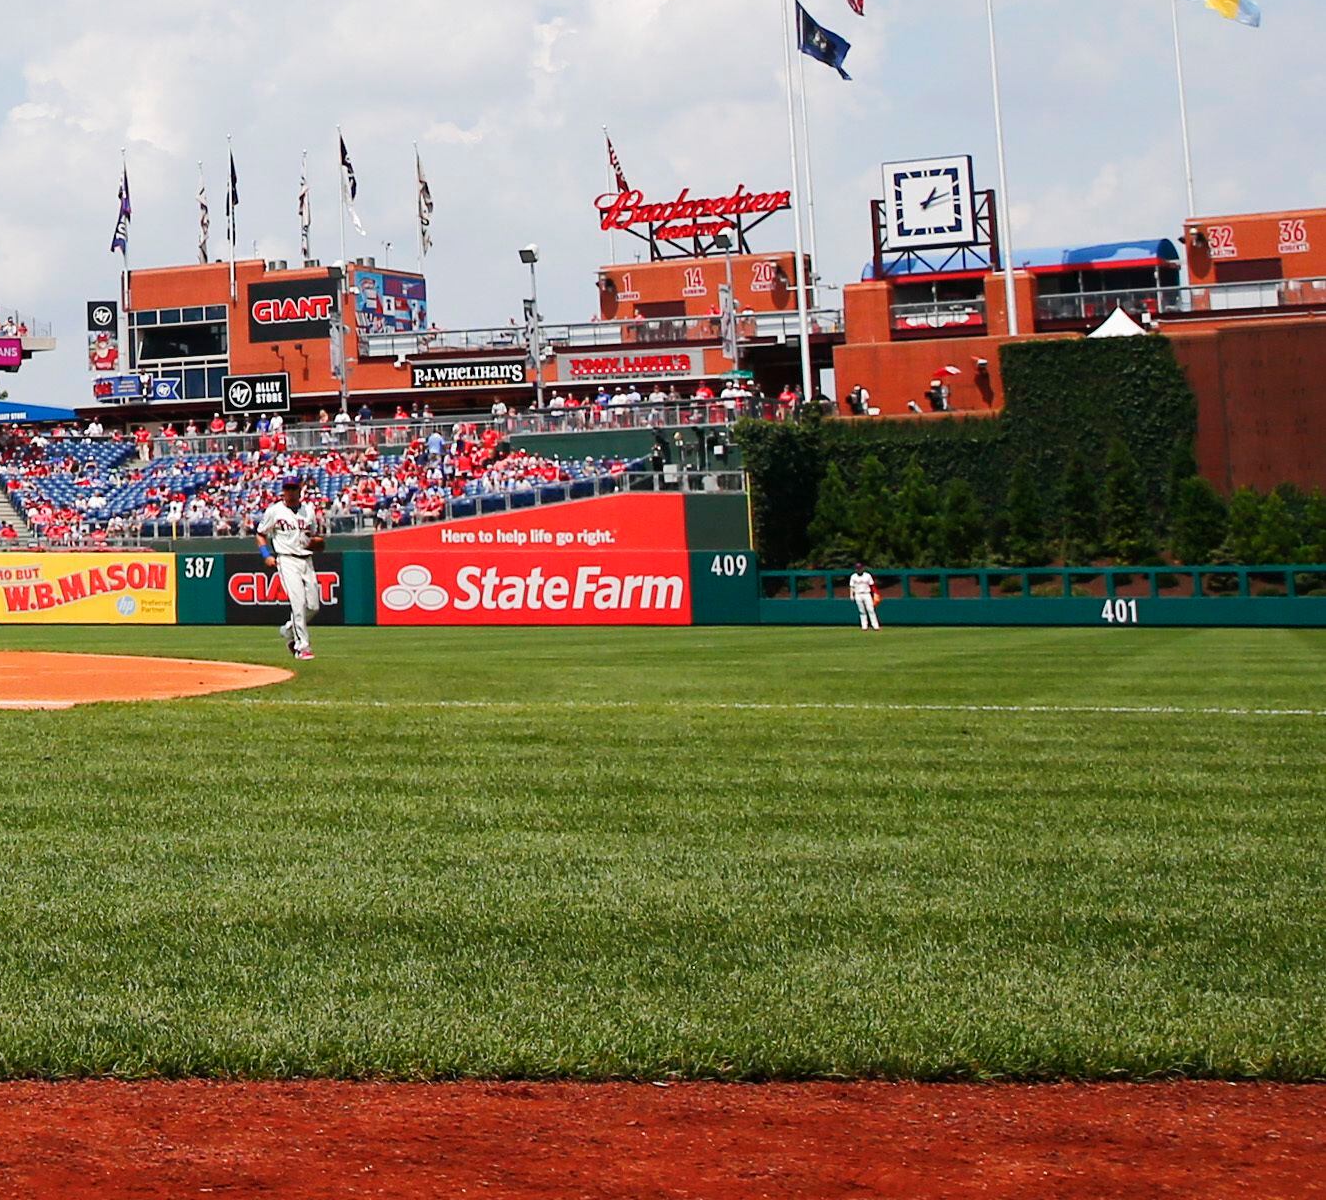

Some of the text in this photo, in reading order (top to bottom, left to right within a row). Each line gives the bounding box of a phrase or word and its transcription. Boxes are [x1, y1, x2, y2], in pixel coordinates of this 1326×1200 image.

[595, 183, 791, 230] Budweiser
[1208, 227, 1232, 248] 32
[1279, 220, 1306, 243] 36
[685, 268, 702, 287] 14
[752, 262, 771, 282] 20
[252, 295, 333, 324] GIANT
[569, 354, 690, 370] TONY LUKE'S
[255, 381, 280, 393] ALLEY
[256, 391, 282, 403] STORE
[441, 529, 615, 547] Here to help life go right.
[16, 568, 39, 580] BUT
[185, 558, 214, 578] 387
[711, 555, 747, 576] 409
[453, 566, 683, 611] State Farm
[1101, 598, 1137, 623] 401
